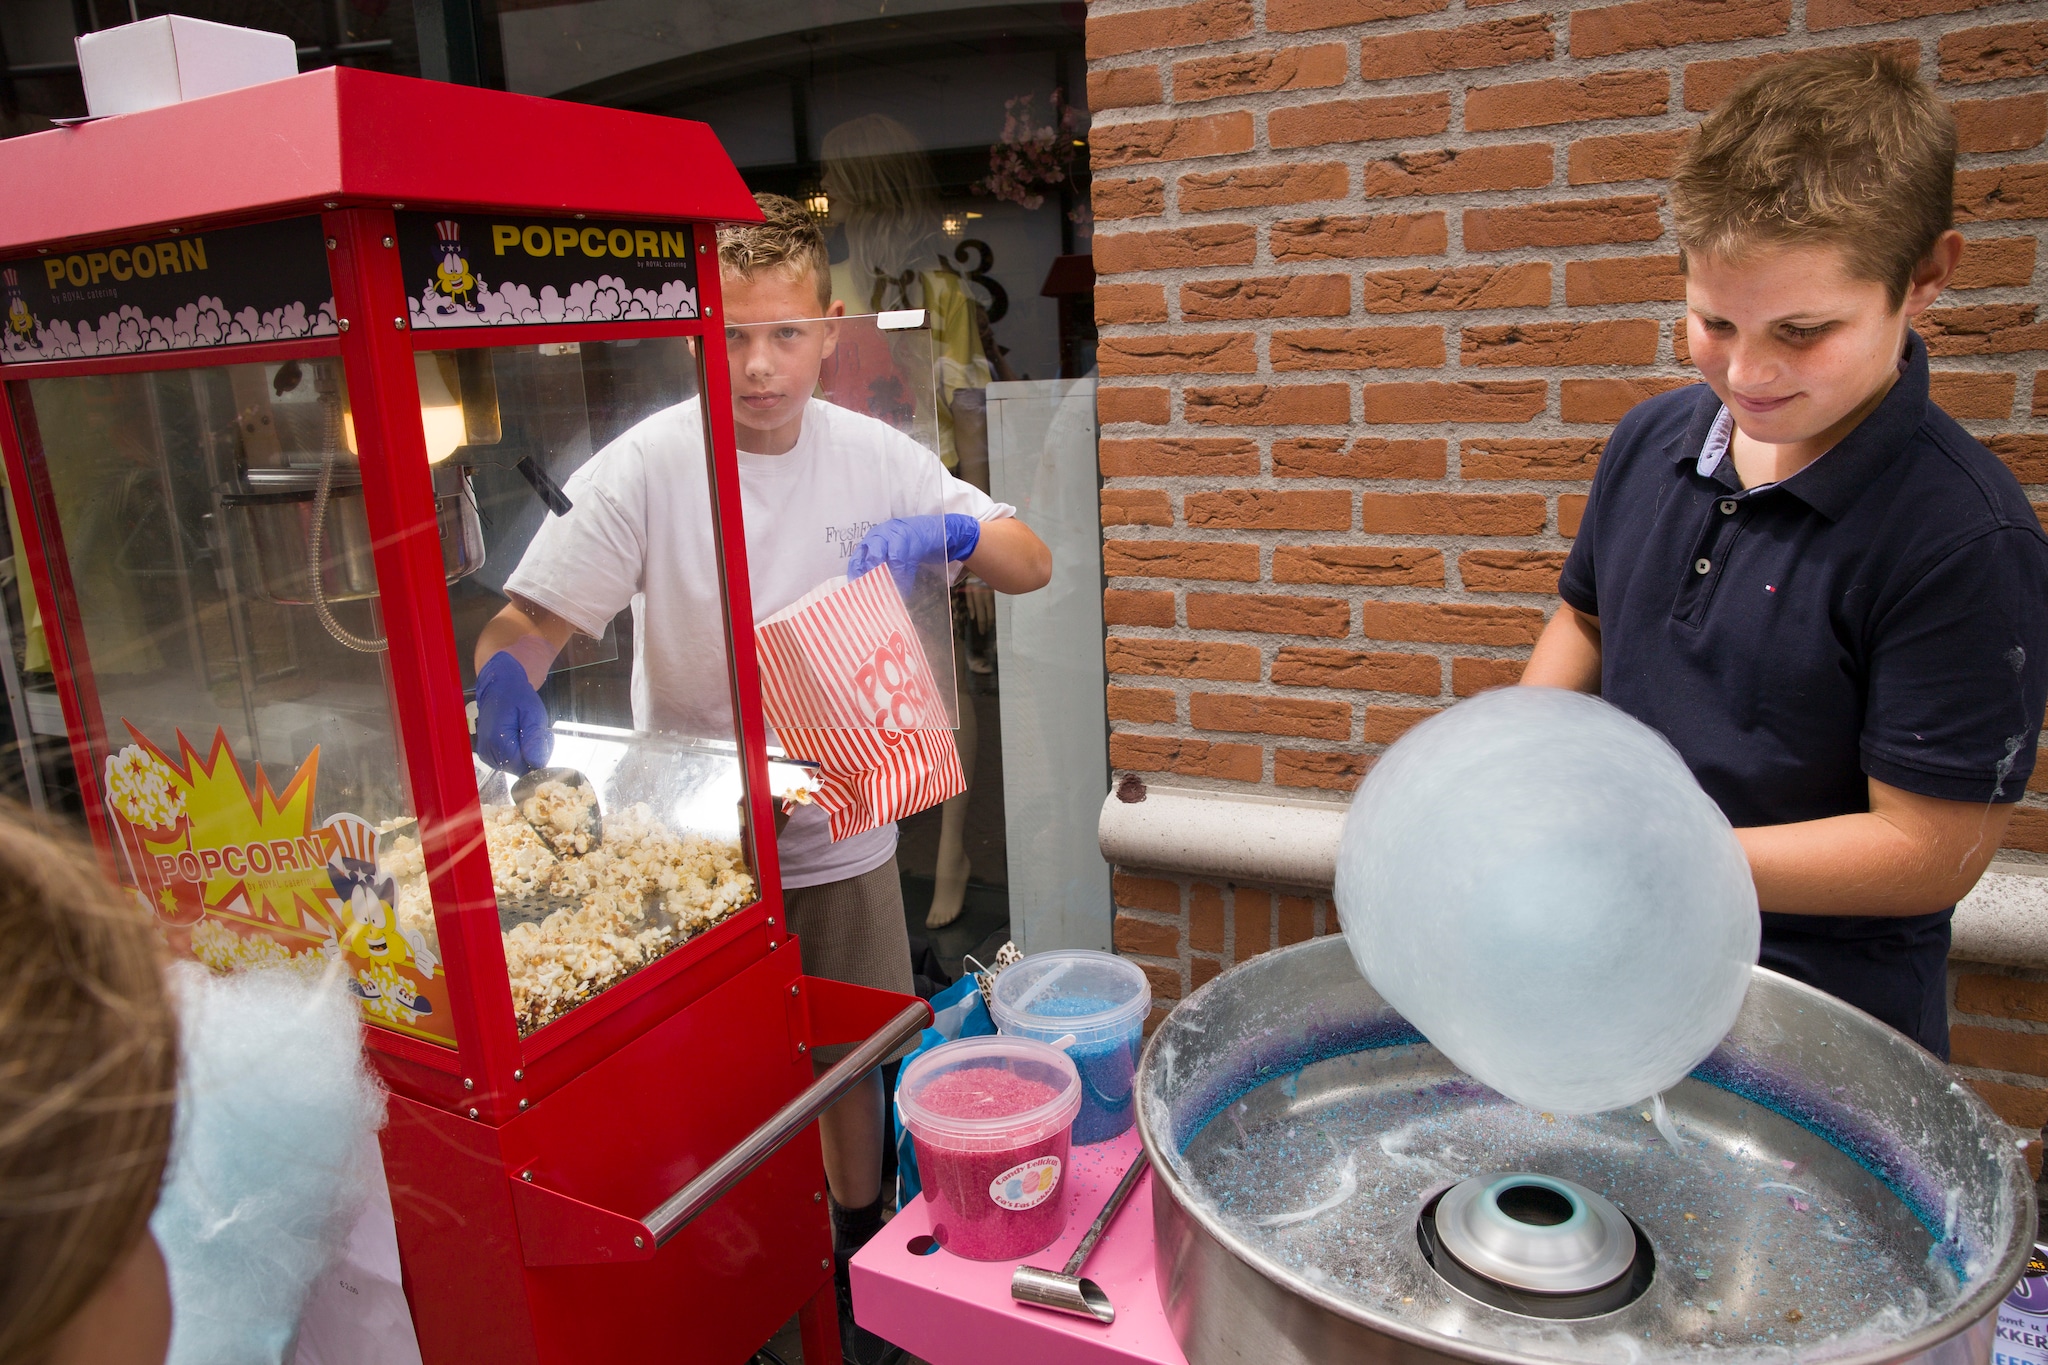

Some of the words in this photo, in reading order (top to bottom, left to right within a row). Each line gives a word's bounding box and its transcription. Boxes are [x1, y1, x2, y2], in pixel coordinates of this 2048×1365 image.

[492, 224, 686, 259] POPCORN
[44, 238, 208, 290] POPCORN
[637, 261, 645, 269] by
[646, 260, 663, 268] ROYAL
[664, 261, 687, 269] catering
[62, 290, 85, 302] ROYAL
[87, 288, 118, 300] catering
[854, 630, 913, 714] POP
[155, 833, 332, 886] POPCORN
[258, 879, 282, 889] ROYAL
[284, 878, 317, 889] catering
[995, 1166, 1025, 1186] Candy
[1998, 1315, 2025, 1328] omt
[1996, 1326, 2048, 1350] KKER
